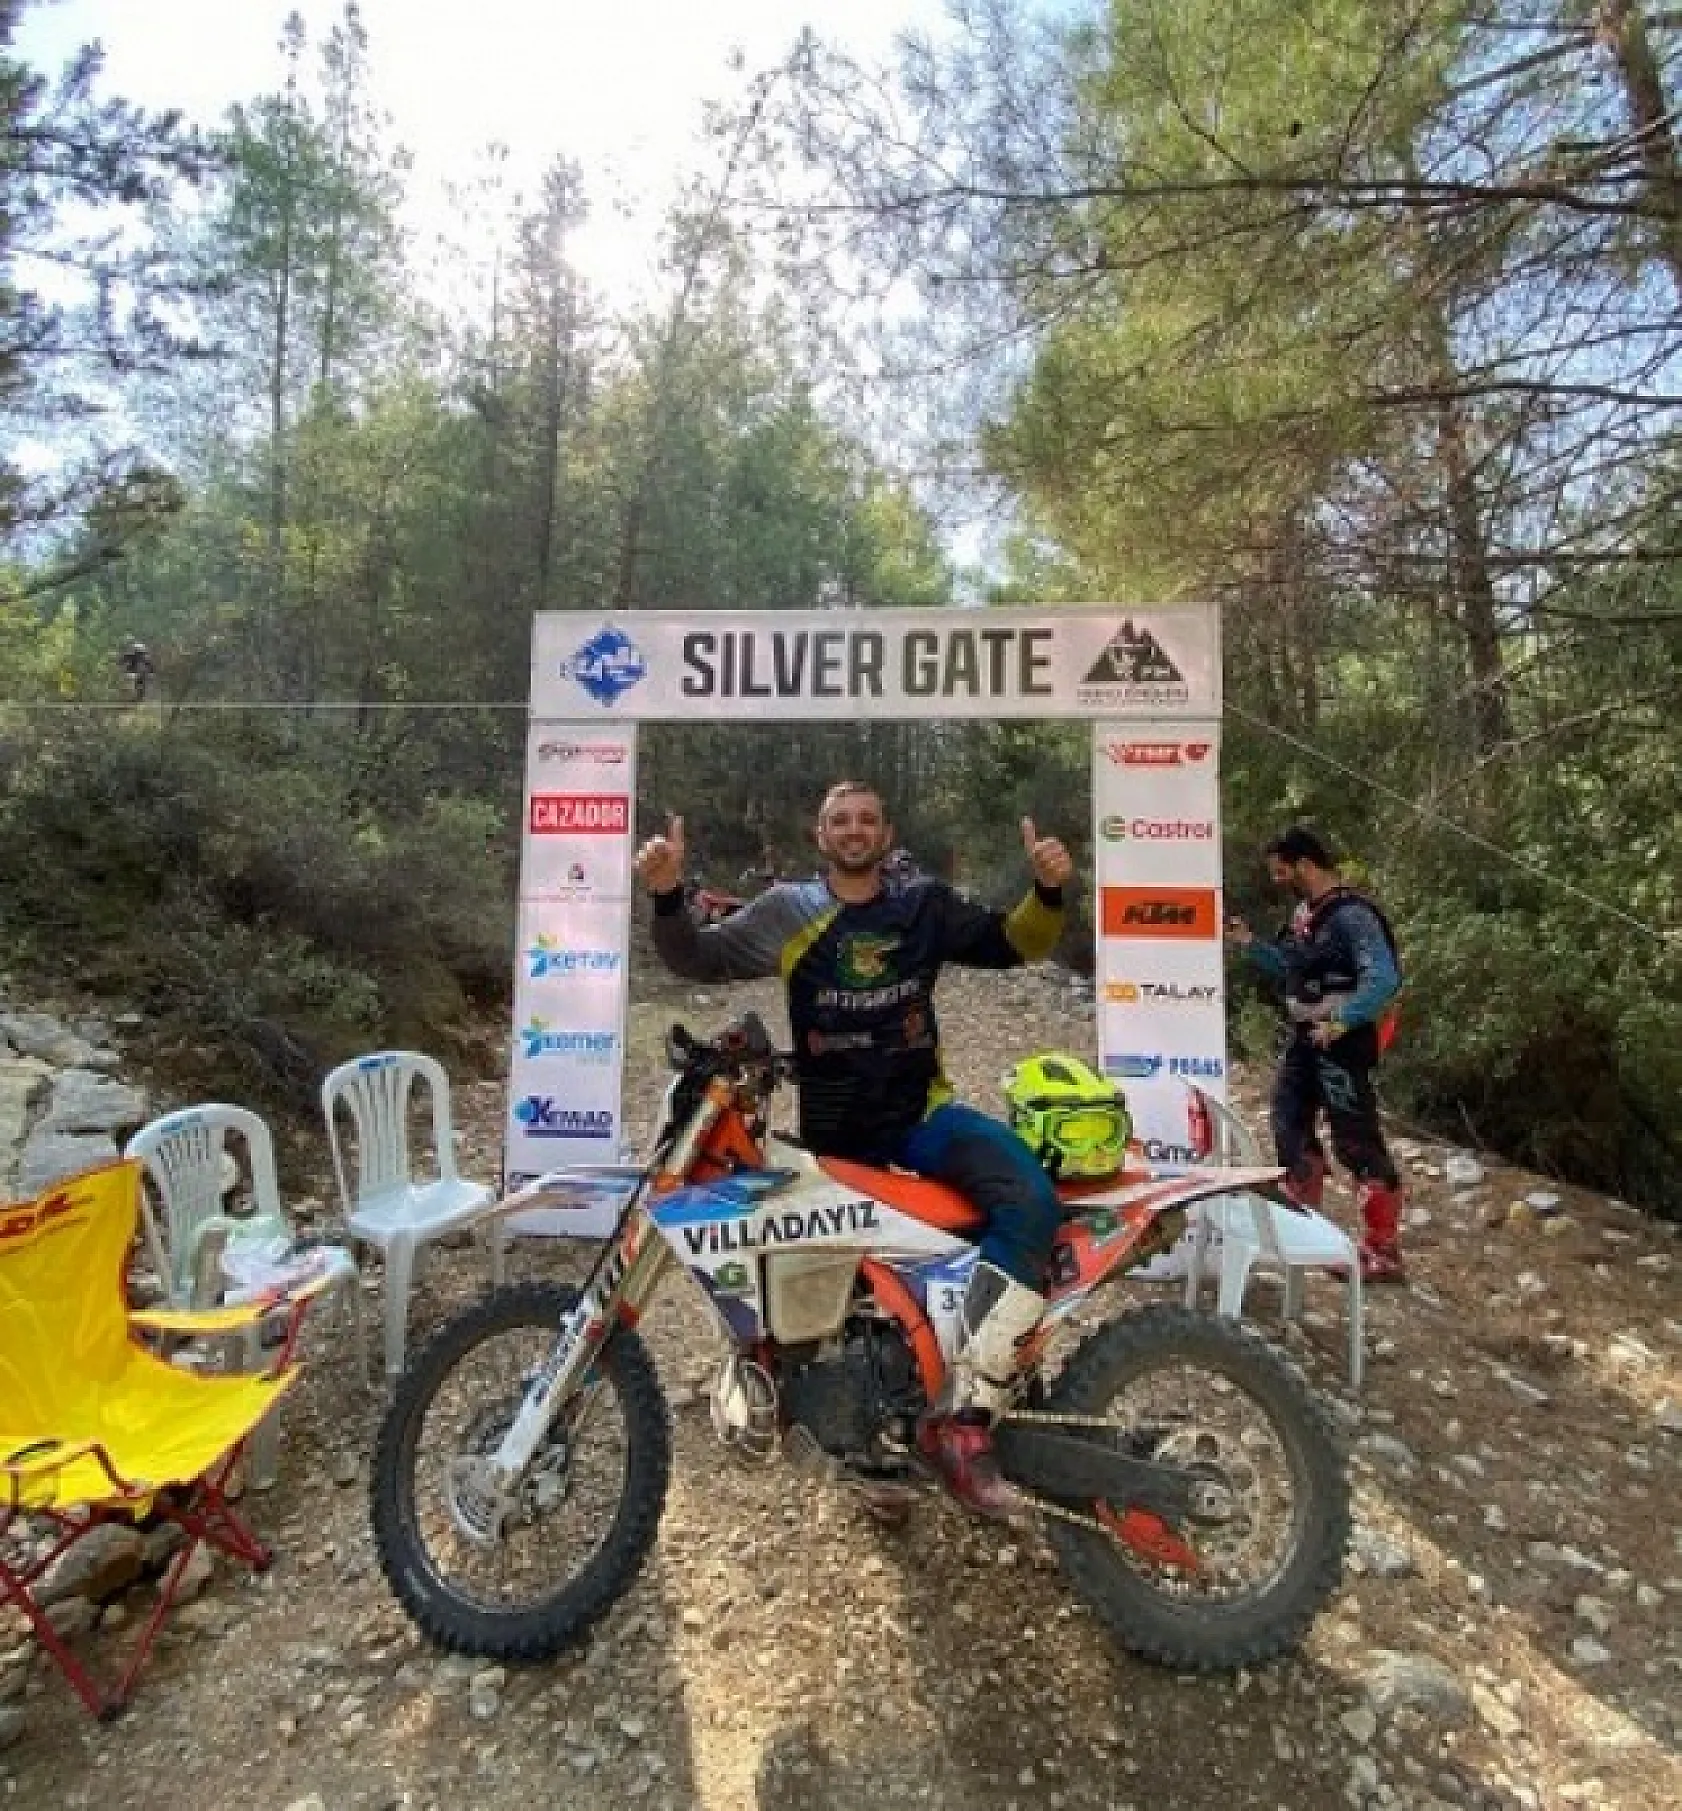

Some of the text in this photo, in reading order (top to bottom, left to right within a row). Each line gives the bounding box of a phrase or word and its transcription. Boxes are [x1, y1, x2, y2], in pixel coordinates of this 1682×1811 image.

[681, 631, 884, 697] SILVER
[900, 628, 1053, 696] GATE
[534, 799, 624, 827] CAZADOR
[1131, 818, 1212, 839] Castrol
[1140, 984, 1217, 998] TALAY
